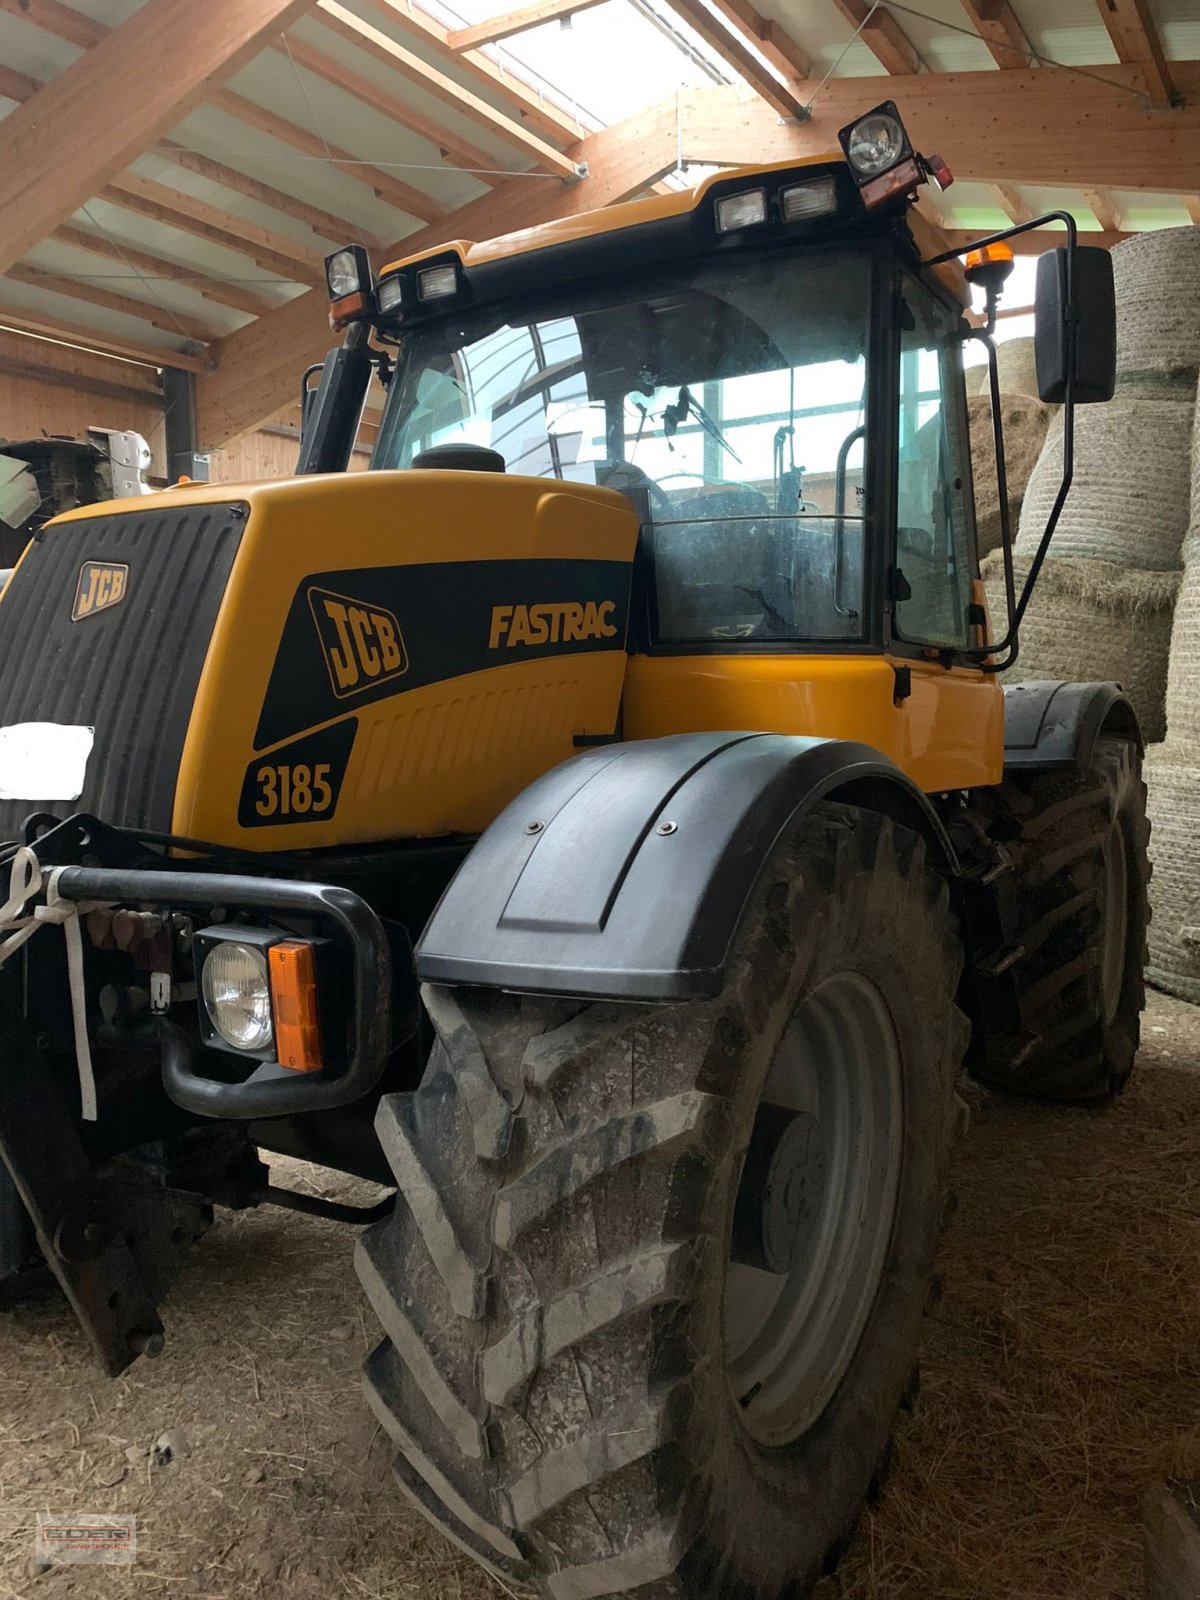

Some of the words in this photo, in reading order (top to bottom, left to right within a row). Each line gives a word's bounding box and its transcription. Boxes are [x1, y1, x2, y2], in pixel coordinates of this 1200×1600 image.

[78, 568, 124, 615] JCB
[323, 599, 401, 689] JCB
[488, 600, 618, 649] FASTRAC
[255, 763, 332, 817] 3185
